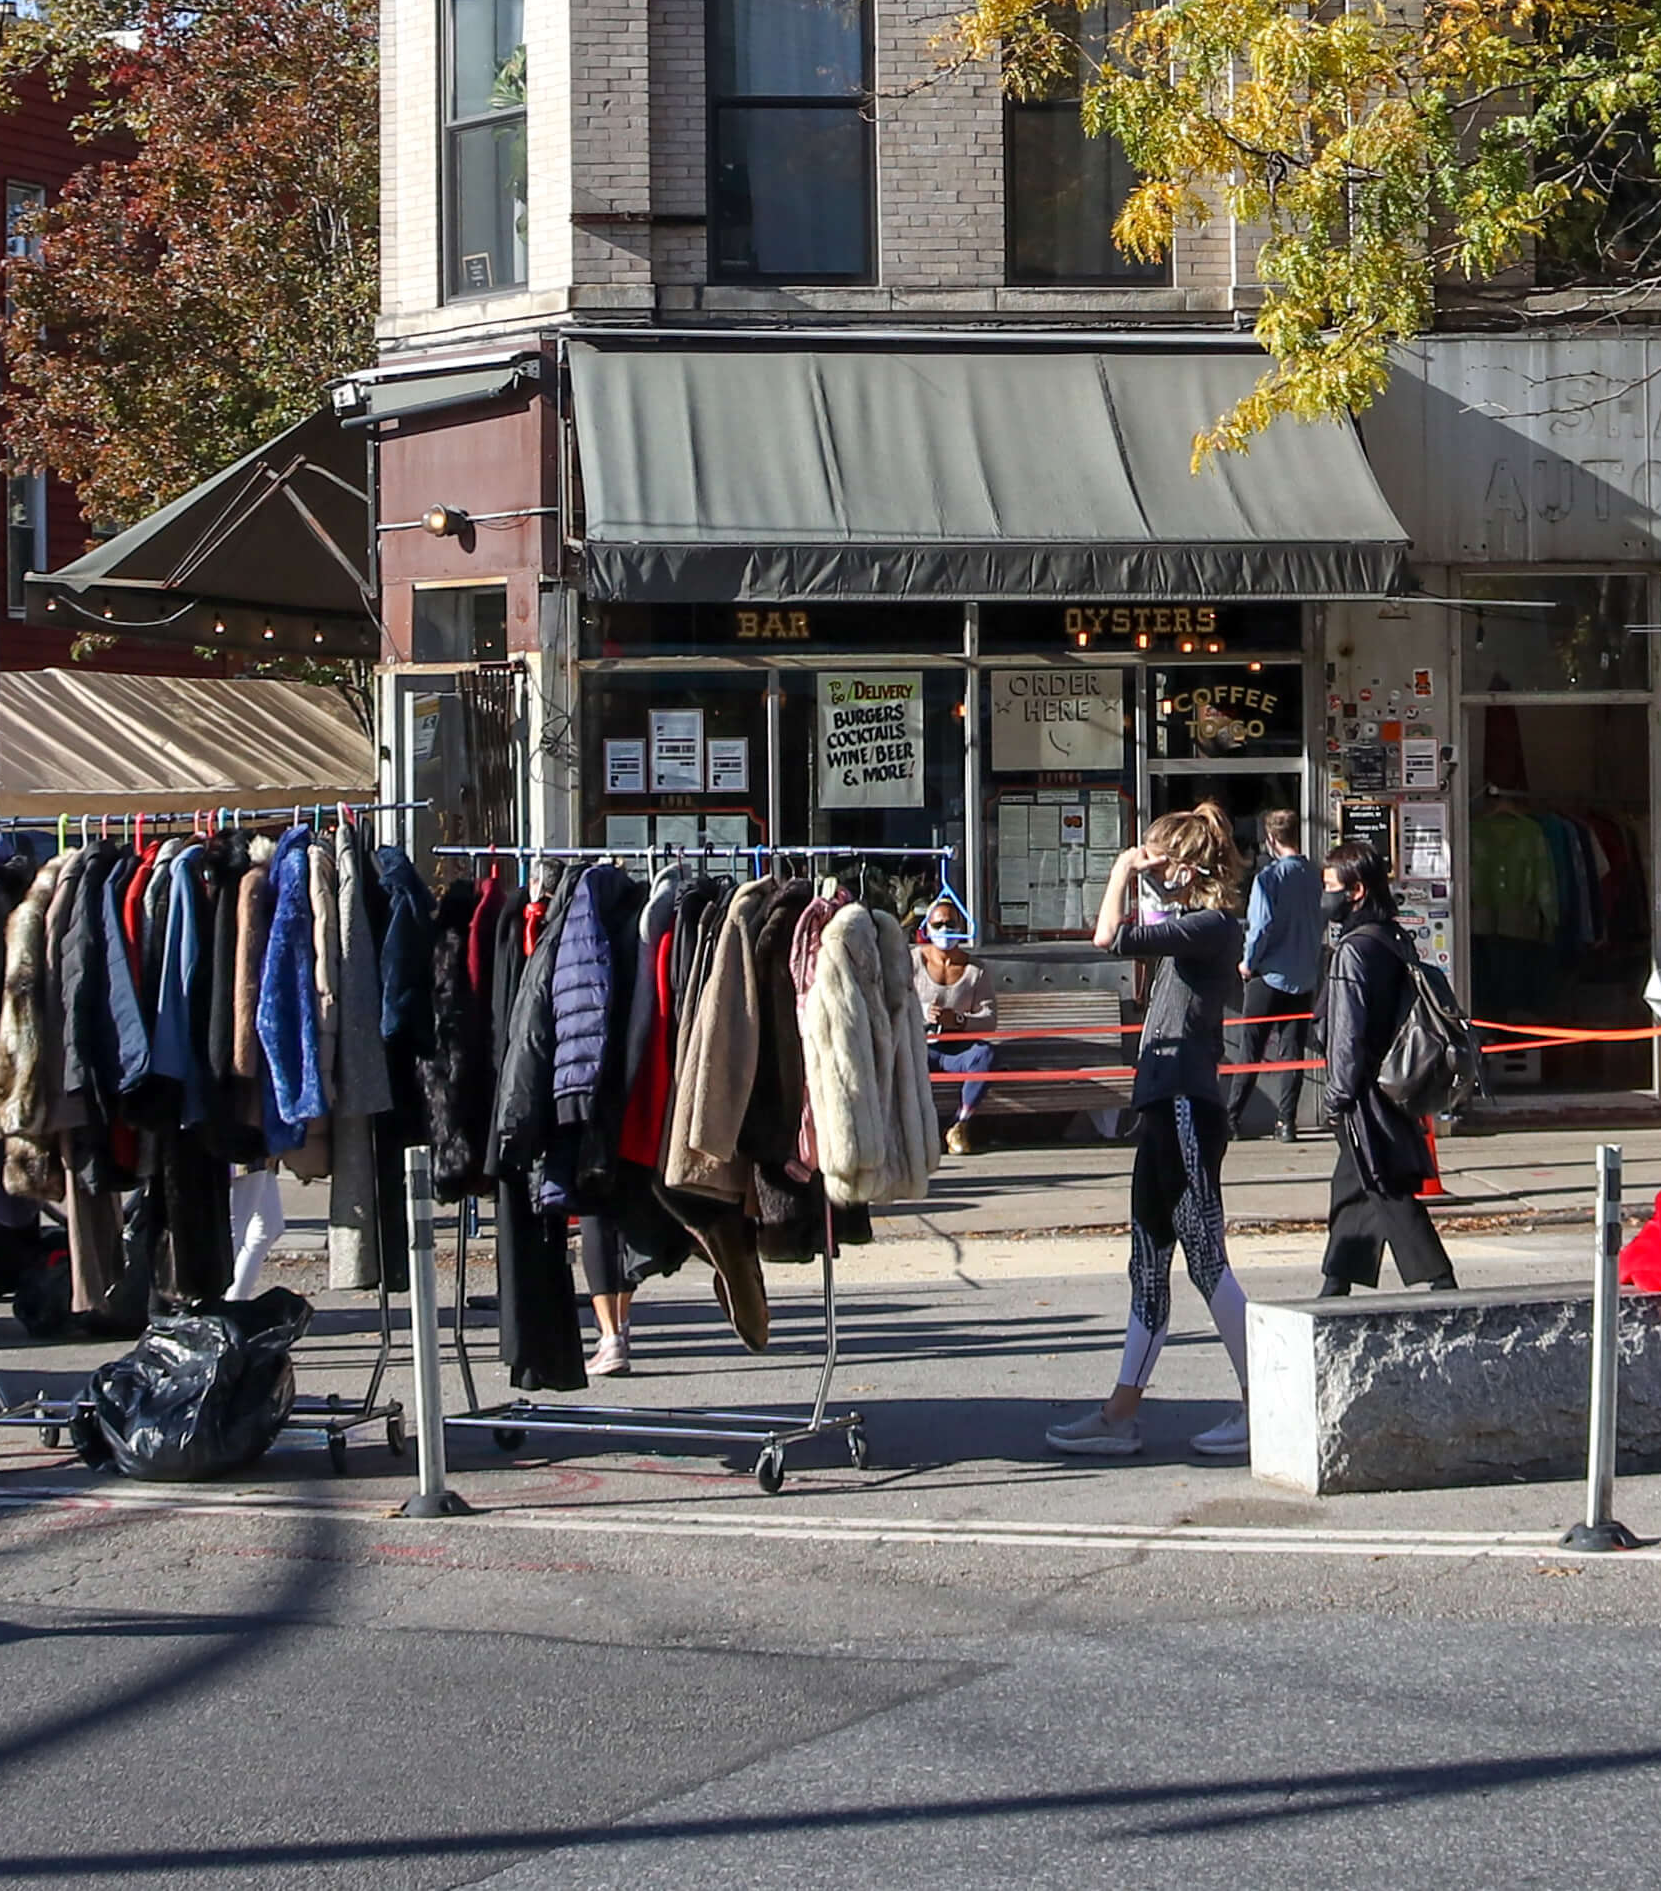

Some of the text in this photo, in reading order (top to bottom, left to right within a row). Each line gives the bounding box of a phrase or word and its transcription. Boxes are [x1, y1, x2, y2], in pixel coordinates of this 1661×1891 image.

[737, 611, 811, 638] BAR
[1065, 608, 1215, 633] OYSTERS
[1008, 672, 1102, 697] ORDER
[1023, 698, 1091, 723] HERE
[1173, 685, 1279, 714] COFFEE
[833, 703, 905, 730] BURGERS
[1184, 719, 1265, 739] TO GO
[826, 722, 907, 749] COCKTAILS
[826, 741, 915, 769] WINE/BEER
[842, 760, 916, 787] & MORE!
